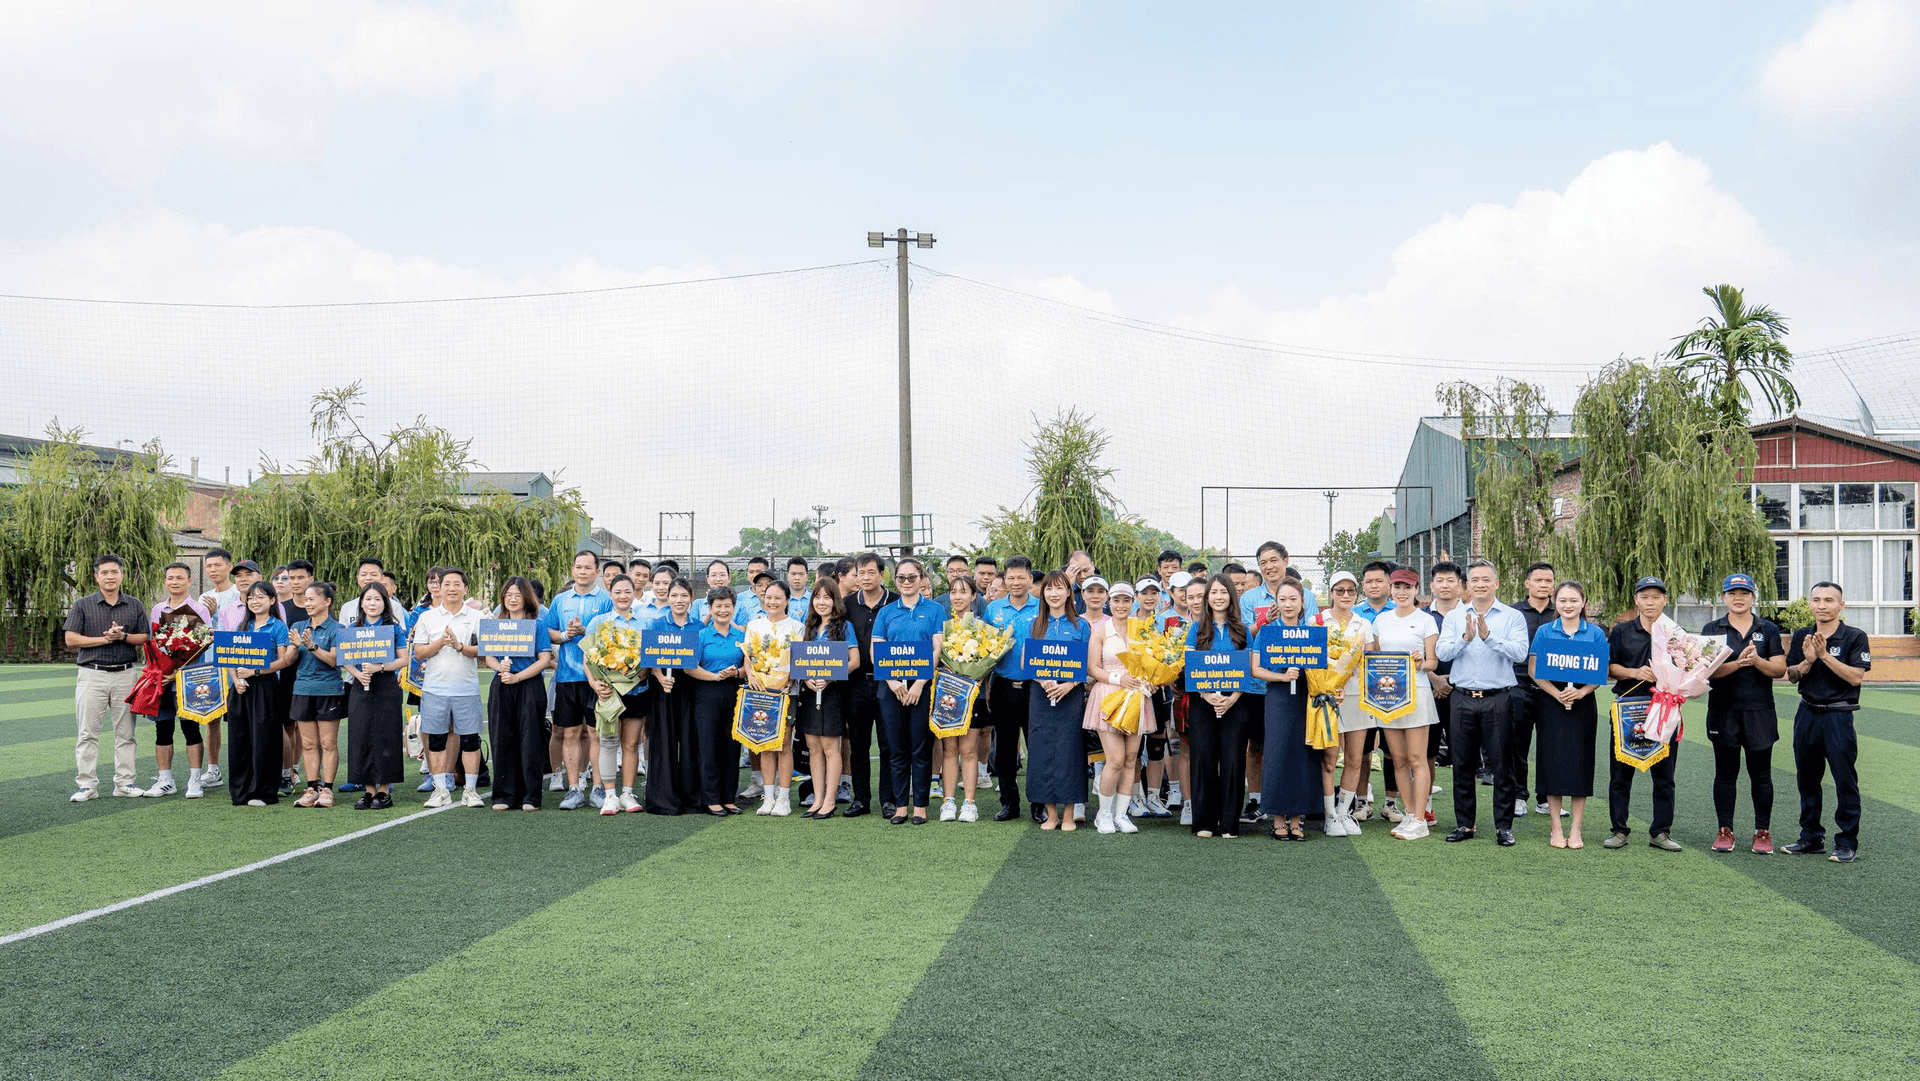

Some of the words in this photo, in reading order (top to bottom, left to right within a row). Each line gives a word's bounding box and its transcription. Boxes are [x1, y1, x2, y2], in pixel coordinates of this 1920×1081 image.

[498, 621, 518, 630] ĐOÀN
[356, 628, 375, 638] ĐOÀN
[1282, 628, 1310, 638] ĐOÀN
[233, 634, 252, 644] ĐOÀN
[658, 634, 682, 644] ĐOÀN
[645, 646, 660, 654] CẢNG
[660, 647, 675, 655] HÀNG
[676, 648, 694, 656] KHÔNG
[806, 644, 830, 654] ĐOÀN
[890, 644, 914, 655] ĐOÀN
[1042, 644, 1068, 655] ĐOÀN
[1266, 644, 1283, 653] CẢNG
[1284, 644, 1300, 654] HÀNG
[1301, 645, 1322, 654] KHÔNG
[795, 658, 810, 666] CẢNG
[810, 658, 824, 666] HÀNG
[825, 658, 843, 666] KHÔNG
[879, 658, 894, 666] CẢNG
[894, 658, 910, 666] HÀNG
[910, 658, 930, 666] KHÔNG
[1030, 656, 1045, 666] CẢNG
[1046, 658, 1062, 666] HÀNG
[1062, 660, 1082, 668] KHÔNG
[1204, 652, 1230, 664] ĐOÀN
[1270, 655, 1286, 664] QUỐC
[1287, 655, 1294, 664] TẾ
[1296, 656, 1306, 666] NỘI
[1307, 656, 1318, 664] BÀI
[1546, 652, 1580, 670] TRỌNG
[1582, 654, 1599, 670] TÀI
[806, 670, 816, 678] THỌ
[817, 668, 832, 676] XUÂN
[890, 669, 904, 678] ĐIỆN
[904, 668, 918, 676] BIÊN
[1036, 668, 1052, 677] QUỐC
[1052, 668, 1060, 678] TẾ
[1190, 668, 1206, 678] CẢNG
[1208, 670, 1224, 678] HÀNG
[1224, 669, 1244, 678] KHÔNG
[1196, 680, 1212, 689] QUỐC
[1213, 680, 1220, 688] TẾ
[1221, 680, 1232, 688] CÁT
